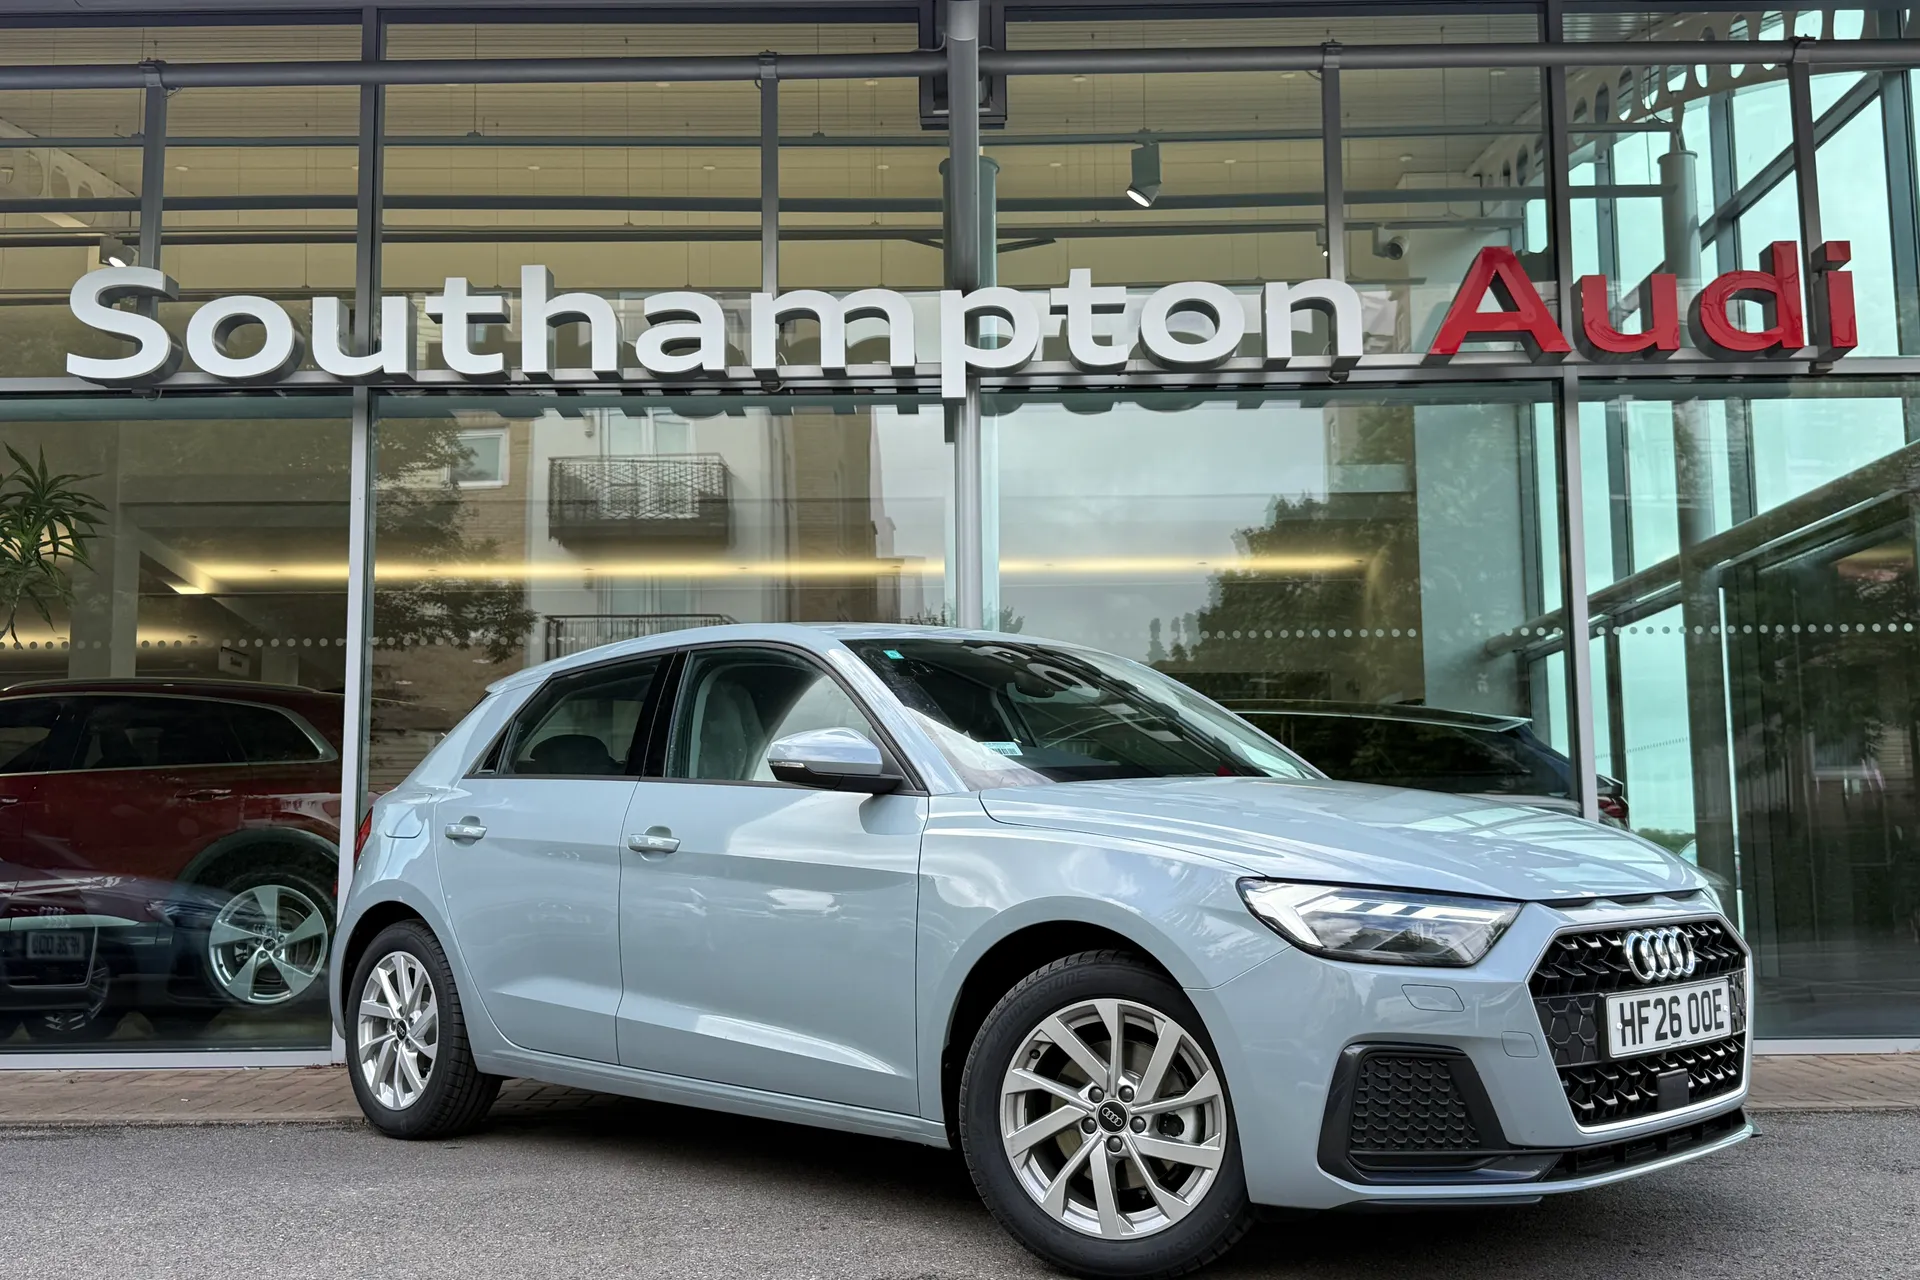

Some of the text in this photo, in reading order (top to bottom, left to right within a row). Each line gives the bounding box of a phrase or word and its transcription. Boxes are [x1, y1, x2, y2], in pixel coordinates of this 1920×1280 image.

[65, 240, 1858, 398] Southampton Audi
[1619, 988, 1725, 1047] HF26 OOE
